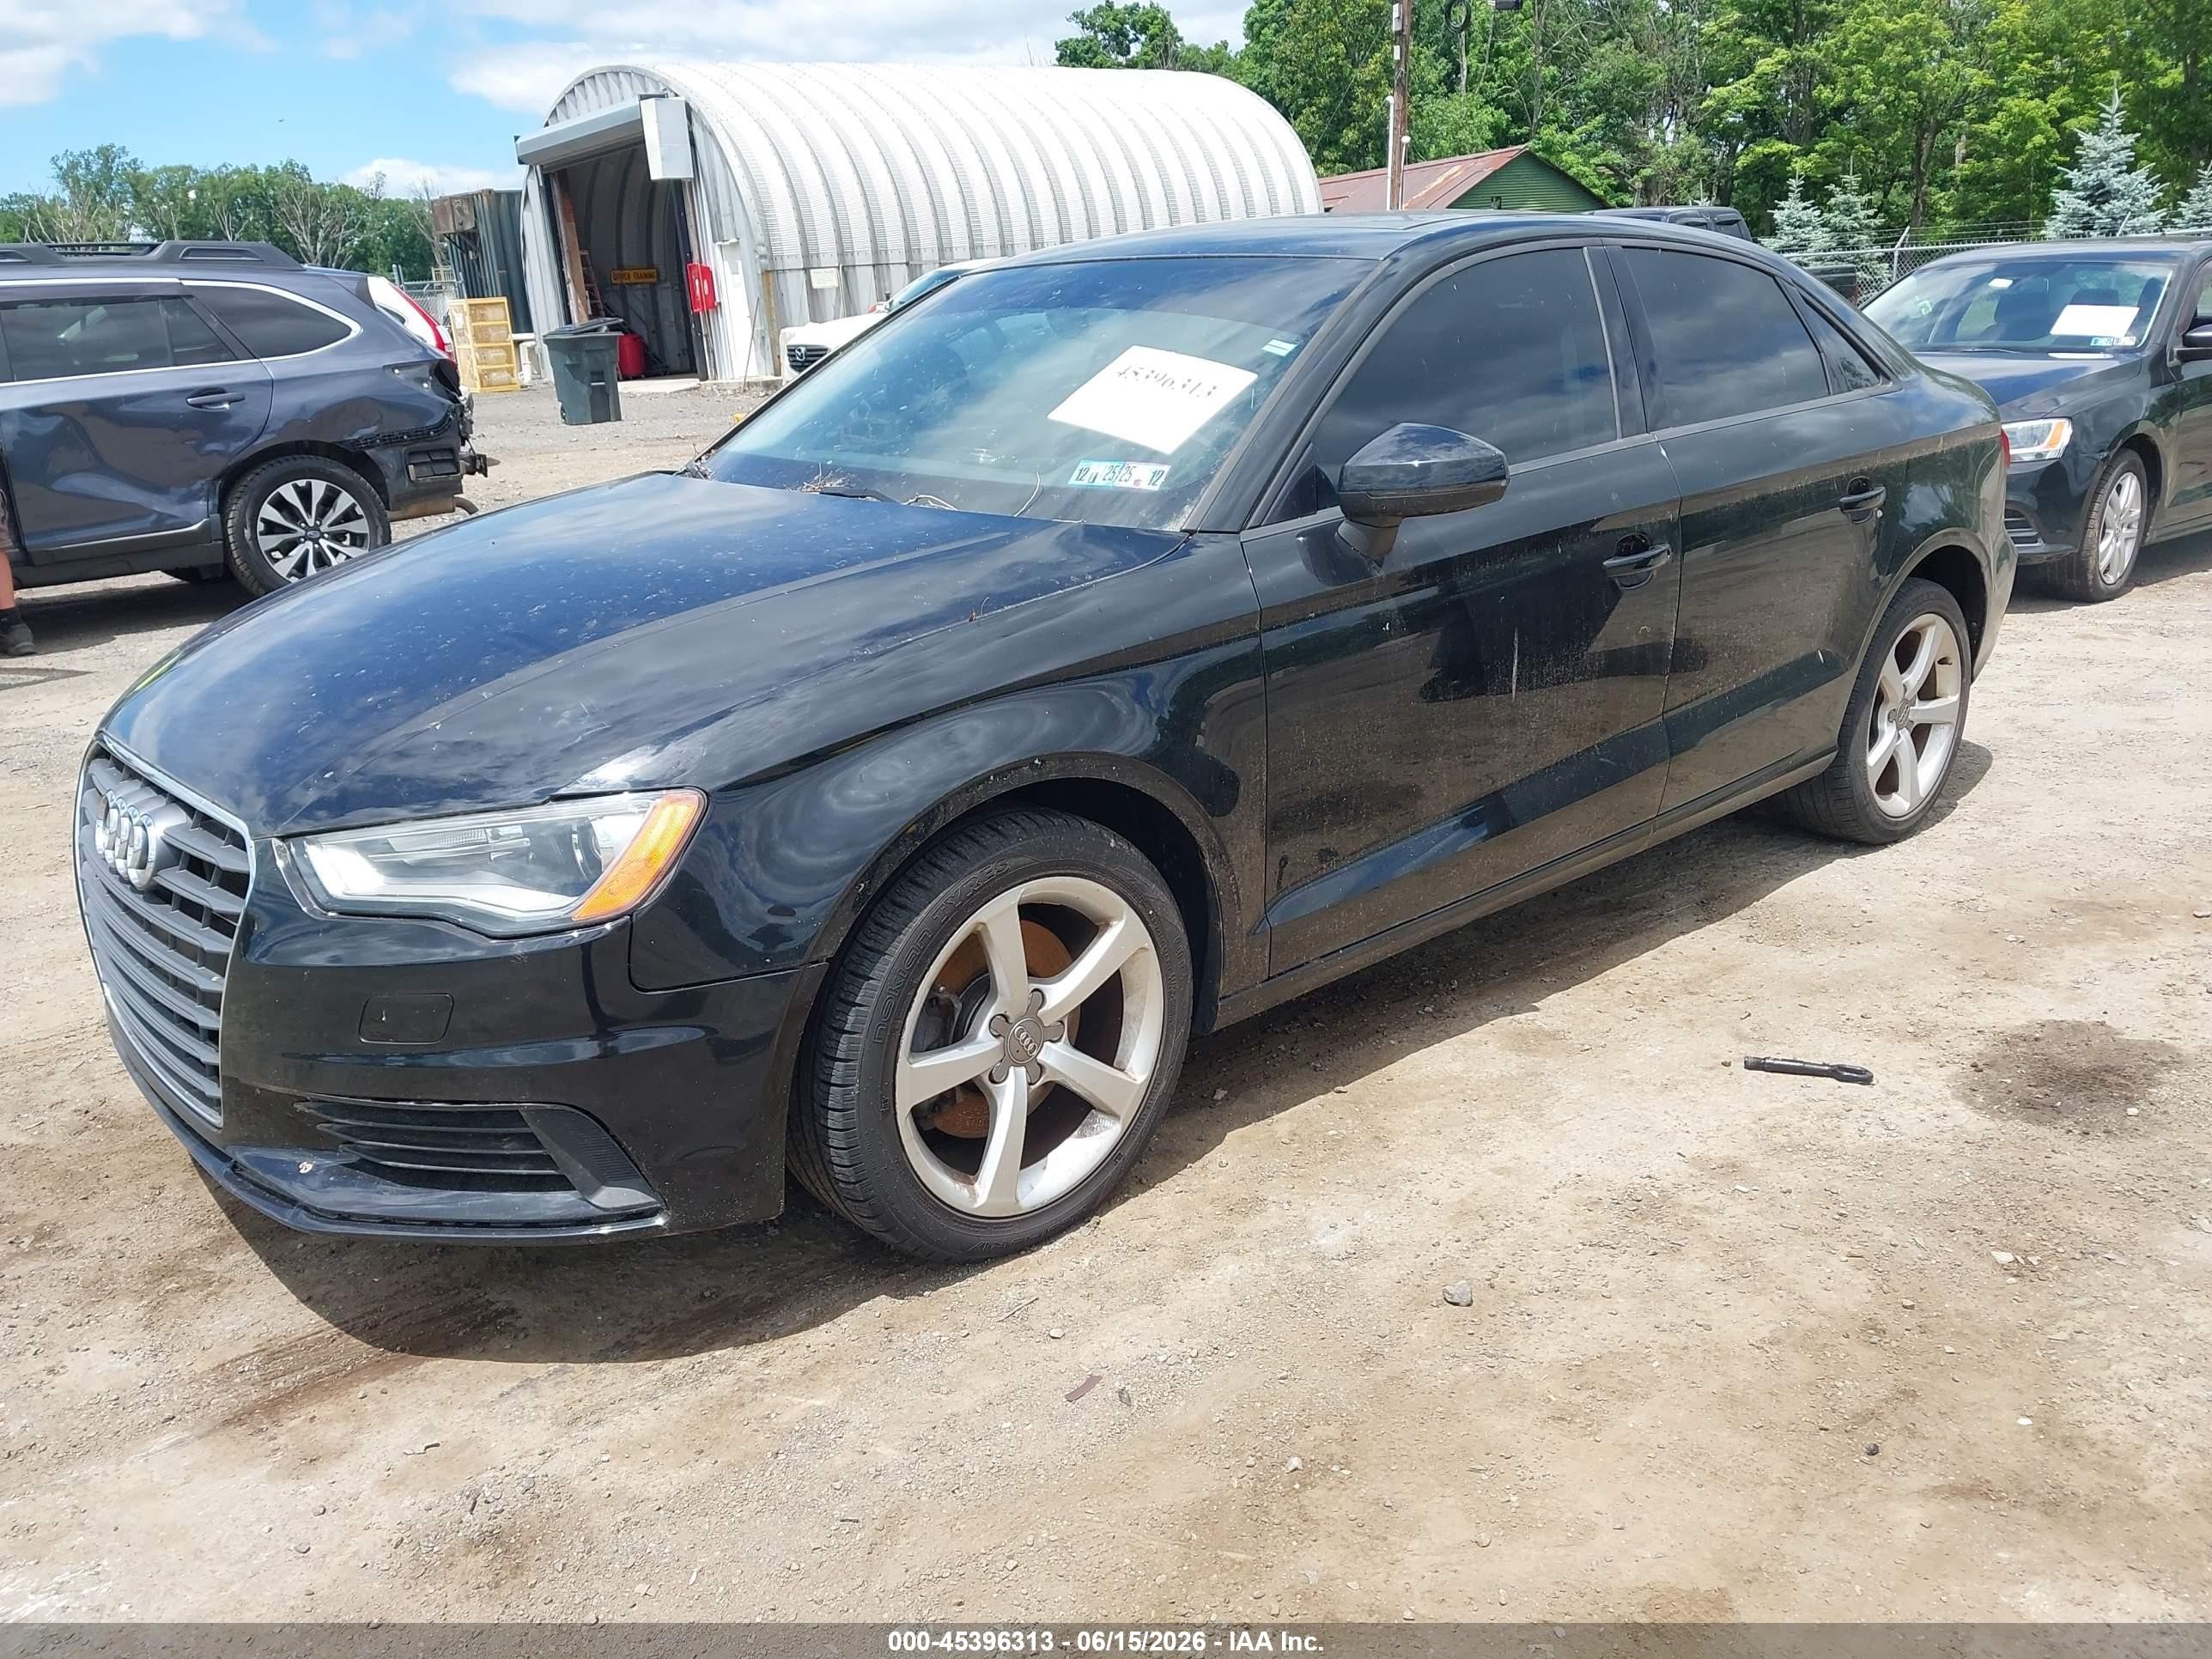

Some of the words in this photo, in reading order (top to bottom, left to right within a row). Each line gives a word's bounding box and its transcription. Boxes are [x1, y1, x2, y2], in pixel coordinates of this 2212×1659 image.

[1075, 467, 1090, 482] 12
[1103, 465, 1120, 482] 25
[1119, 465, 1137, 482] 25
[1148, 469, 1164, 486] 12
